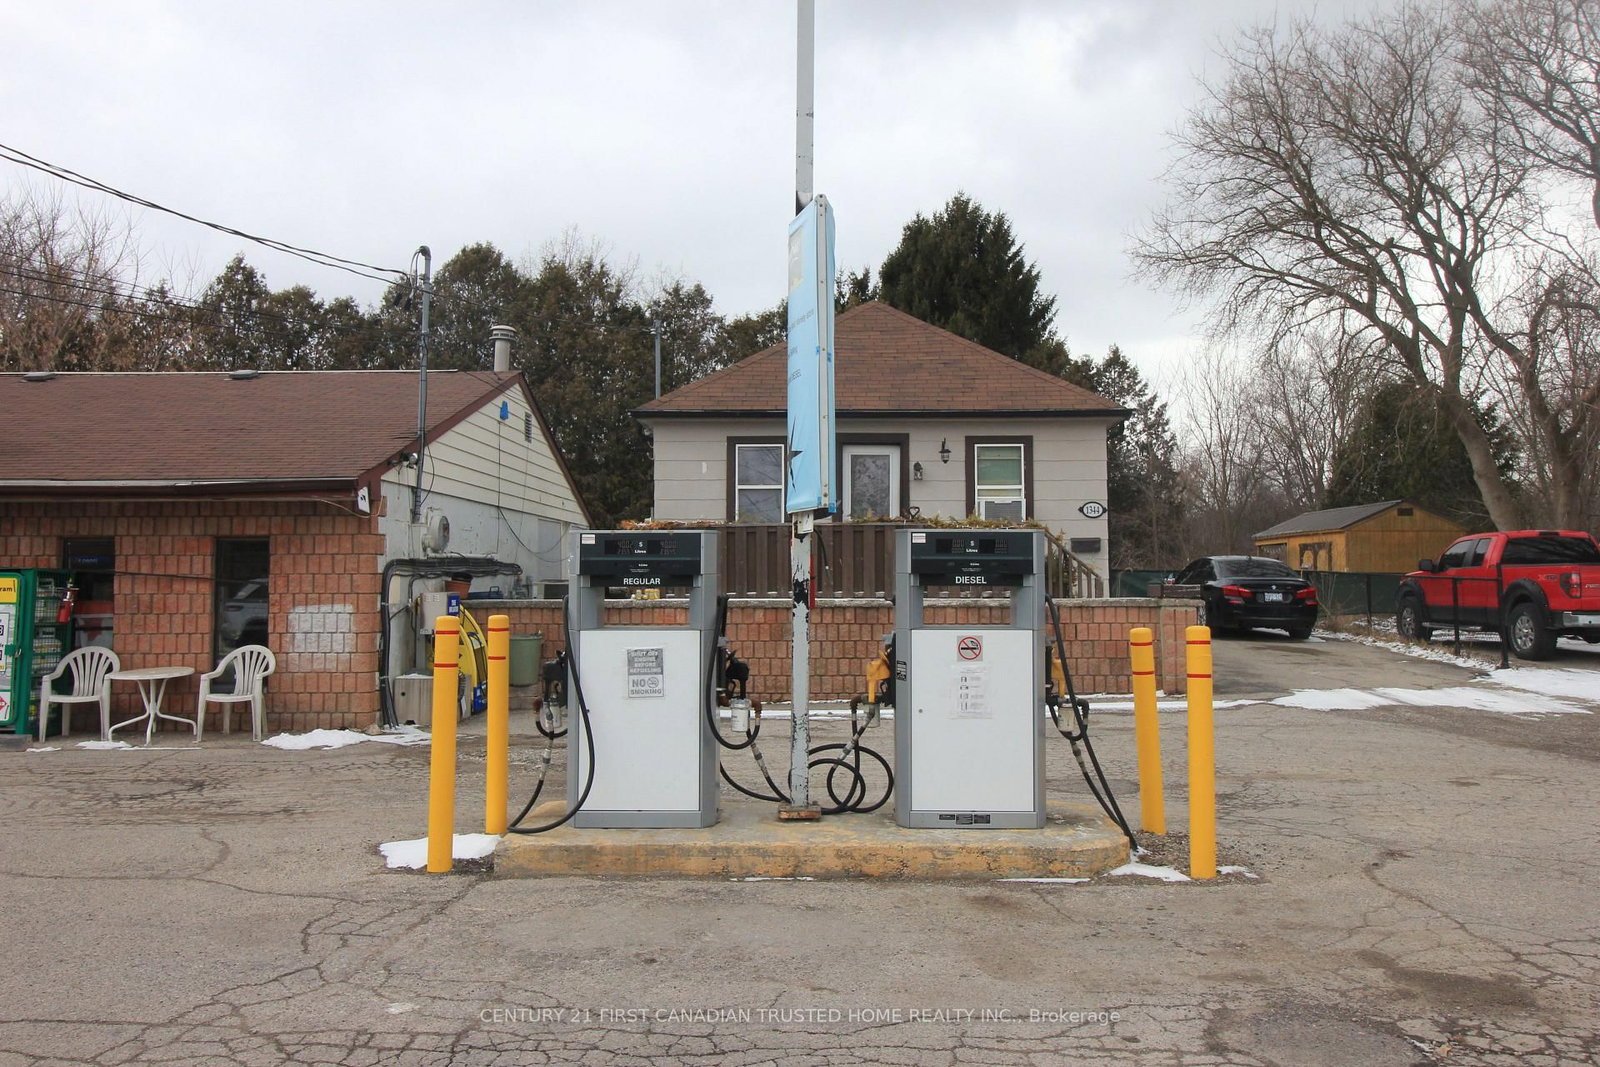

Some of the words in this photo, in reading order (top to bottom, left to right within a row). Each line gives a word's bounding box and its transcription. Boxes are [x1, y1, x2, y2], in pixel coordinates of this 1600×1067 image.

[1085, 505, 1100, 514] 1344
[955, 576, 987, 584] DIESEL
[632, 679, 646, 688] NO
